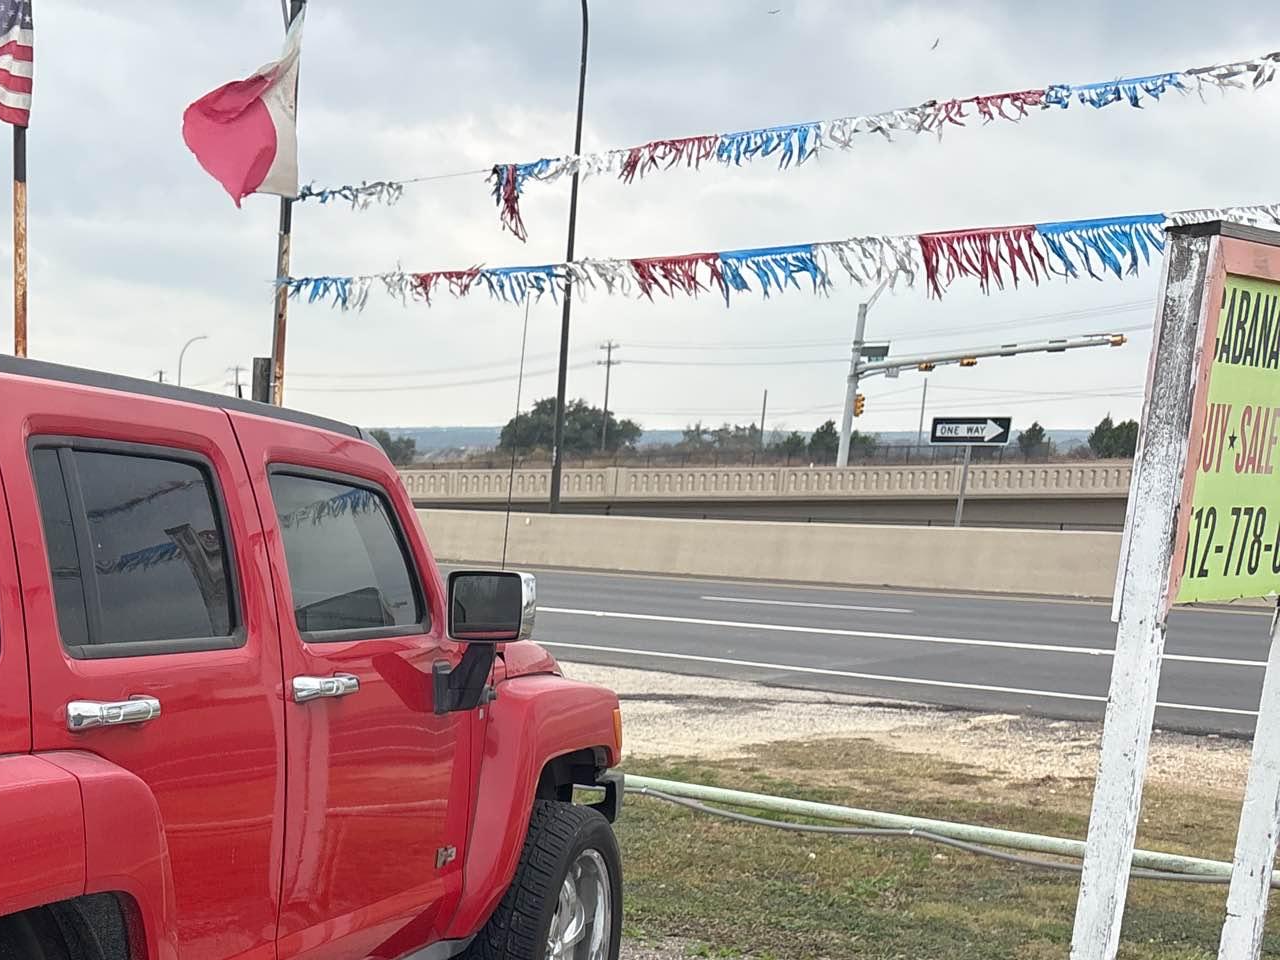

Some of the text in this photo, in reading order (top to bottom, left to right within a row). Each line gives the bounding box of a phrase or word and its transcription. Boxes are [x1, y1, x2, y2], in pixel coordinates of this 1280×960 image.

[940, 426, 986, 435] ONE WAY
[1197, 403, 1232, 473] UY
[1182, 506, 1280, 578] 12-778-
